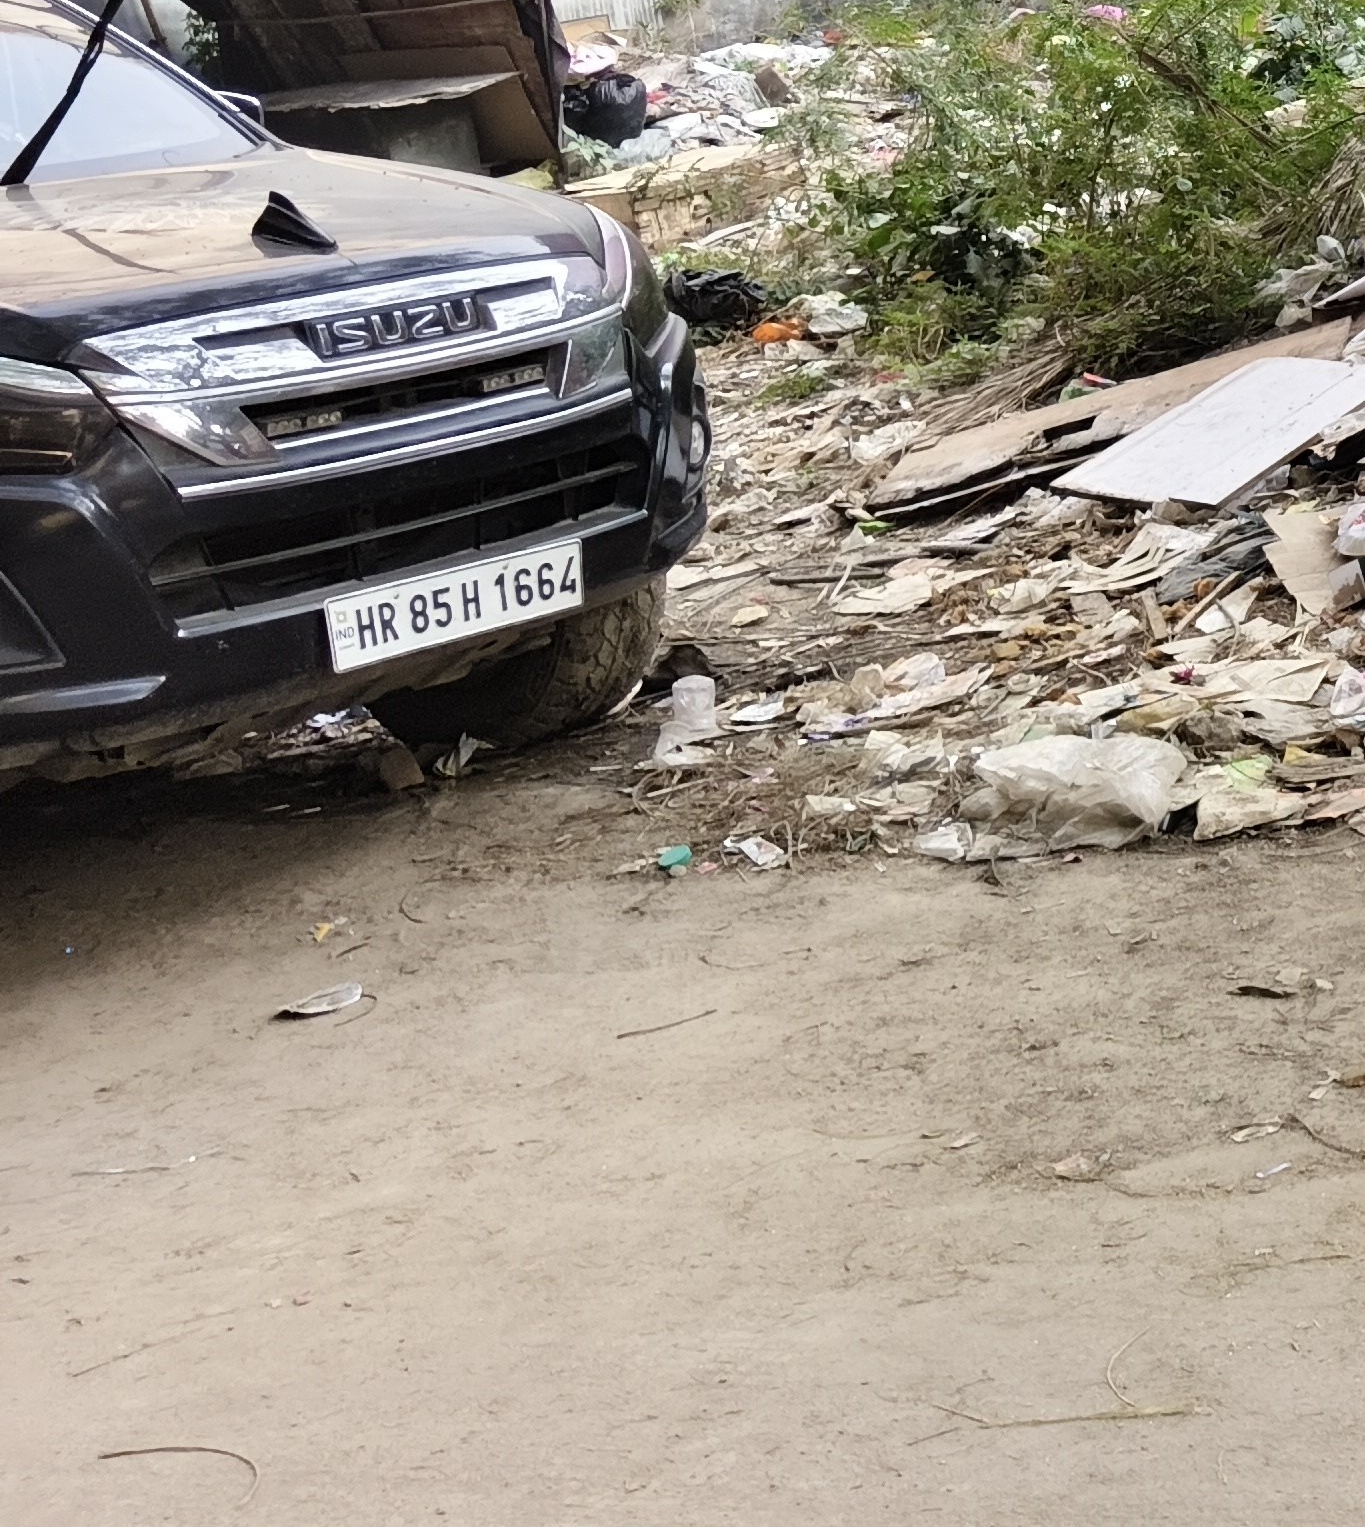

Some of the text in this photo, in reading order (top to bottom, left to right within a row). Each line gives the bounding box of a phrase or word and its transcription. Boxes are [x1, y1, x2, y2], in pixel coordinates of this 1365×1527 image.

[314, 297, 480, 356] ISUZU
[355, 555, 577, 650] HR 85 H 1664
[335, 625, 356, 641] IND
